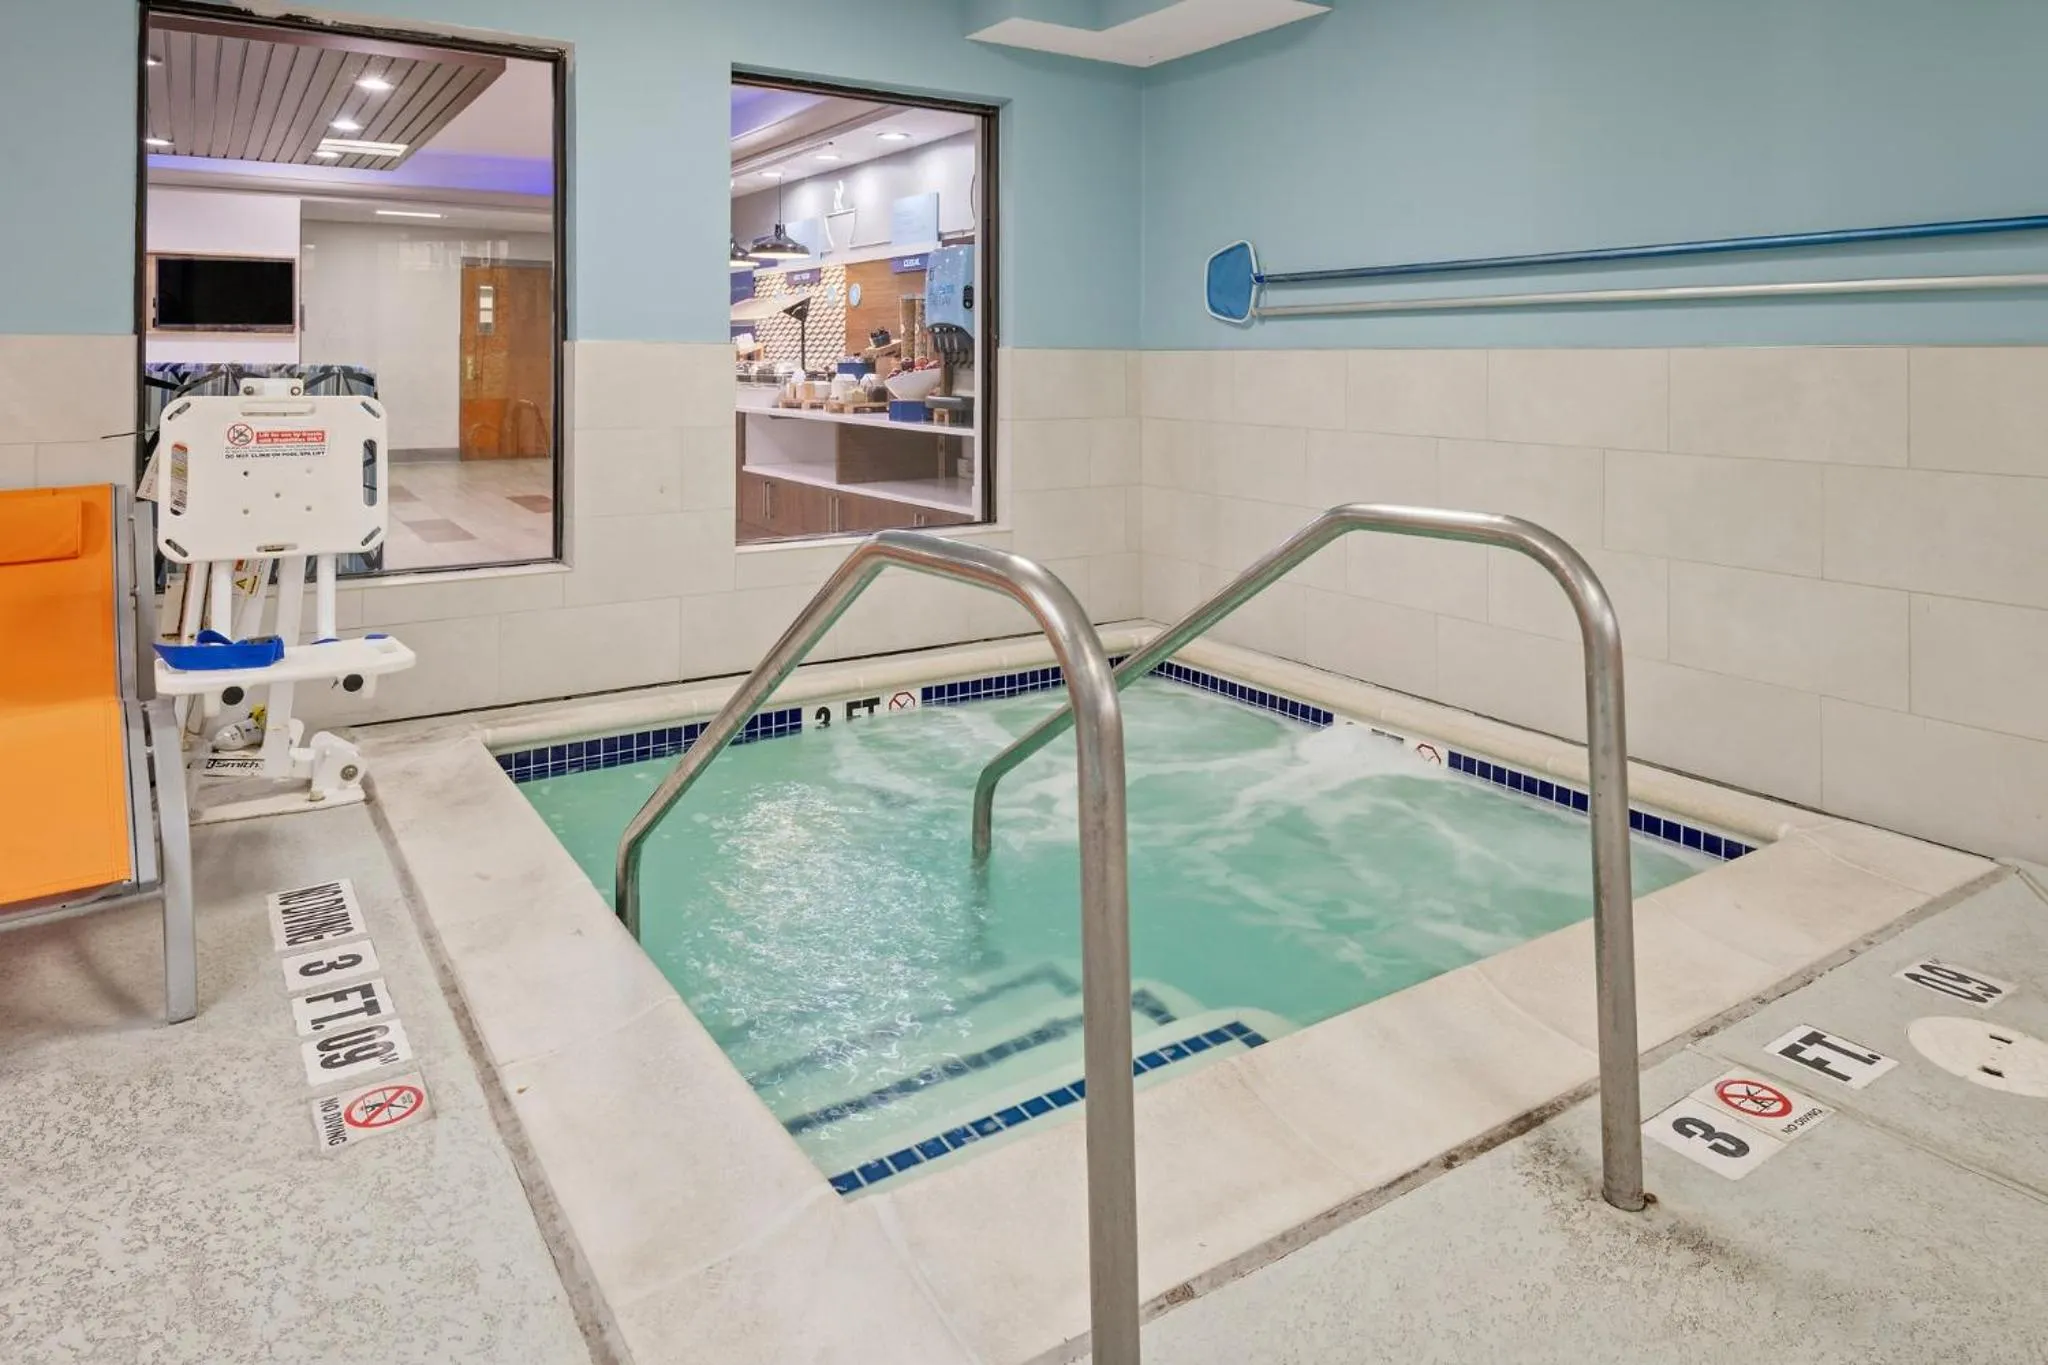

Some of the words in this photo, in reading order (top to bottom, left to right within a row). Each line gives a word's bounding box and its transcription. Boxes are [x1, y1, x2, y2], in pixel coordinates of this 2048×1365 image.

[278, 882, 343, 905] NO
[281, 897, 354, 946] DIVING
[298, 953, 363, 977] 3
[319, 1097, 339, 1113] NO
[322, 1112, 348, 1146] DIVING
[1781, 1123, 1798, 1134] NO
[1793, 1107, 1823, 1126] DIVING
[1671, 1116, 1750, 1158] 3
